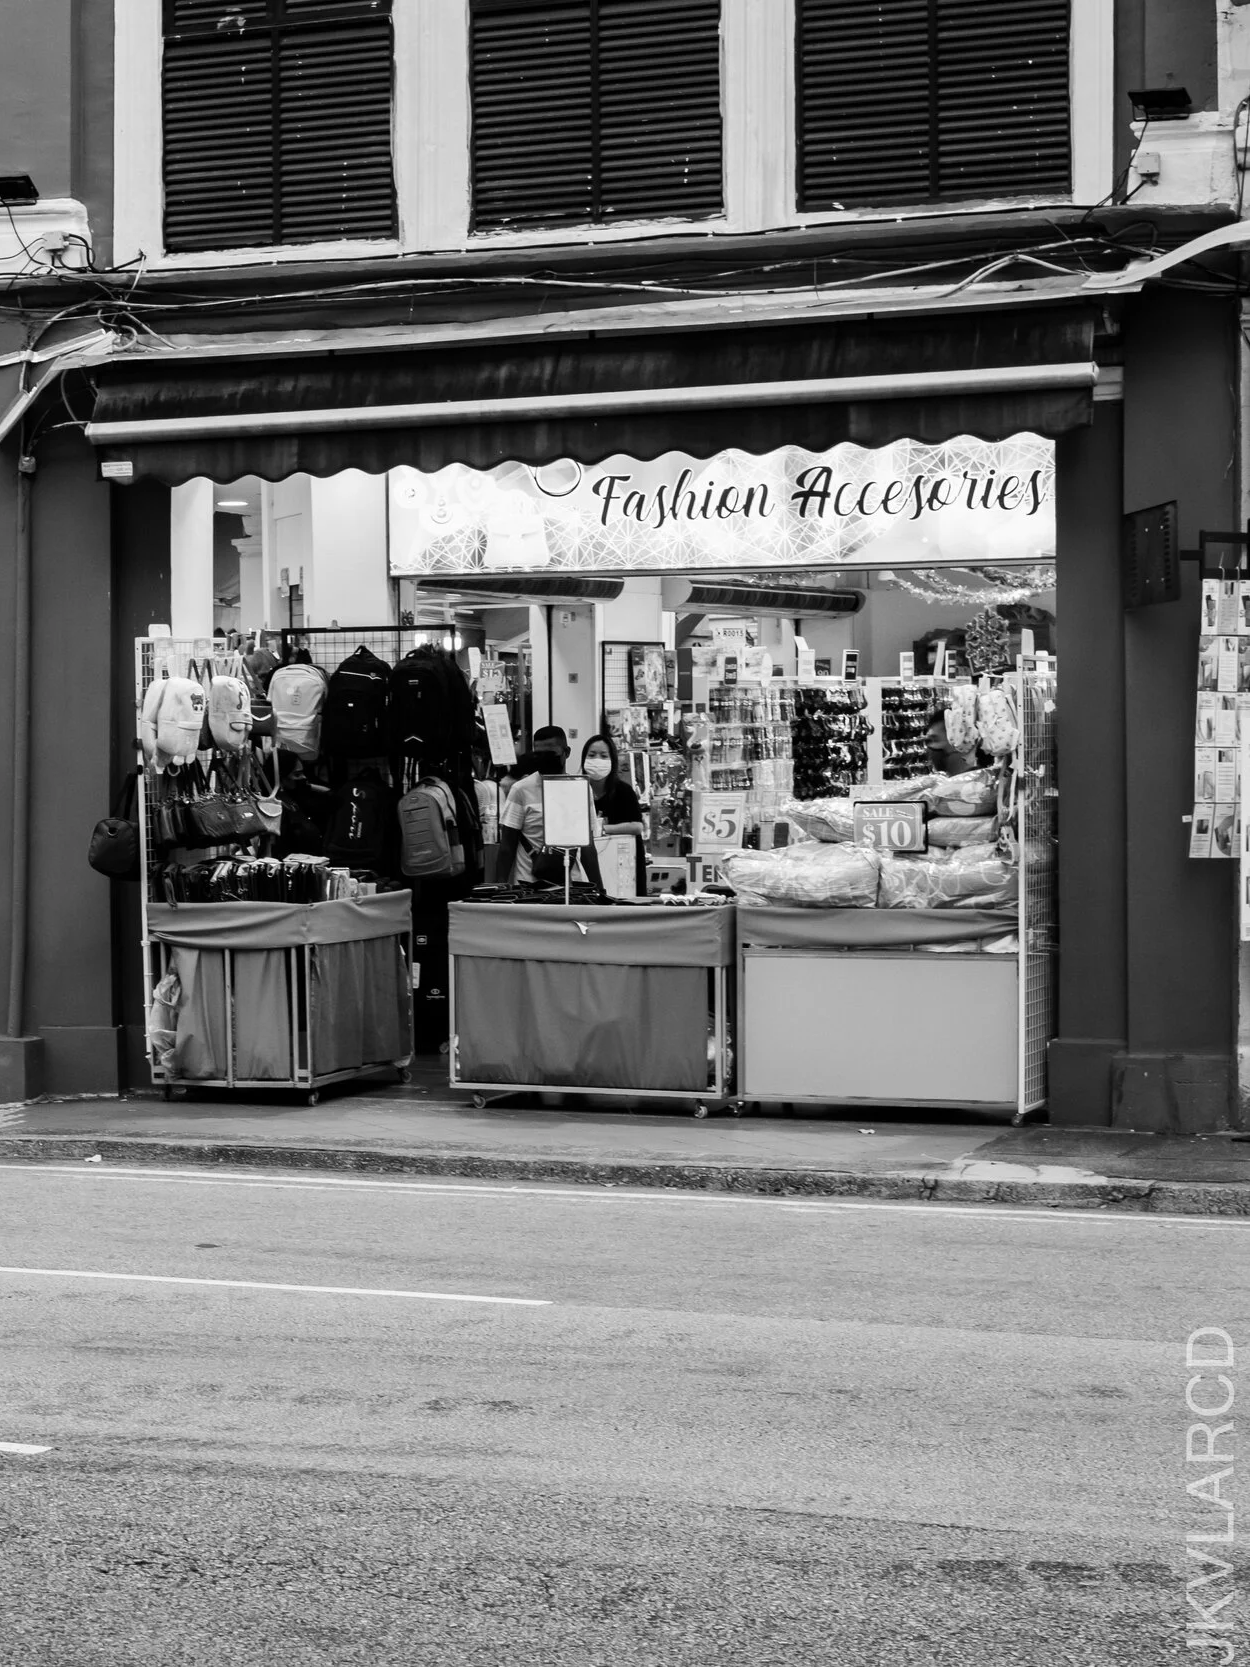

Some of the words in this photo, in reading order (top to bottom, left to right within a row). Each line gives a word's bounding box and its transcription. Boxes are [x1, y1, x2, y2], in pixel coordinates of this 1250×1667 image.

[592, 468, 775, 529] Fashion
[791, 466, 1046, 521] Accesories
[702, 809, 737, 839] $5
[862, 808, 894, 818] SALE
[862, 819, 912, 848] $10
